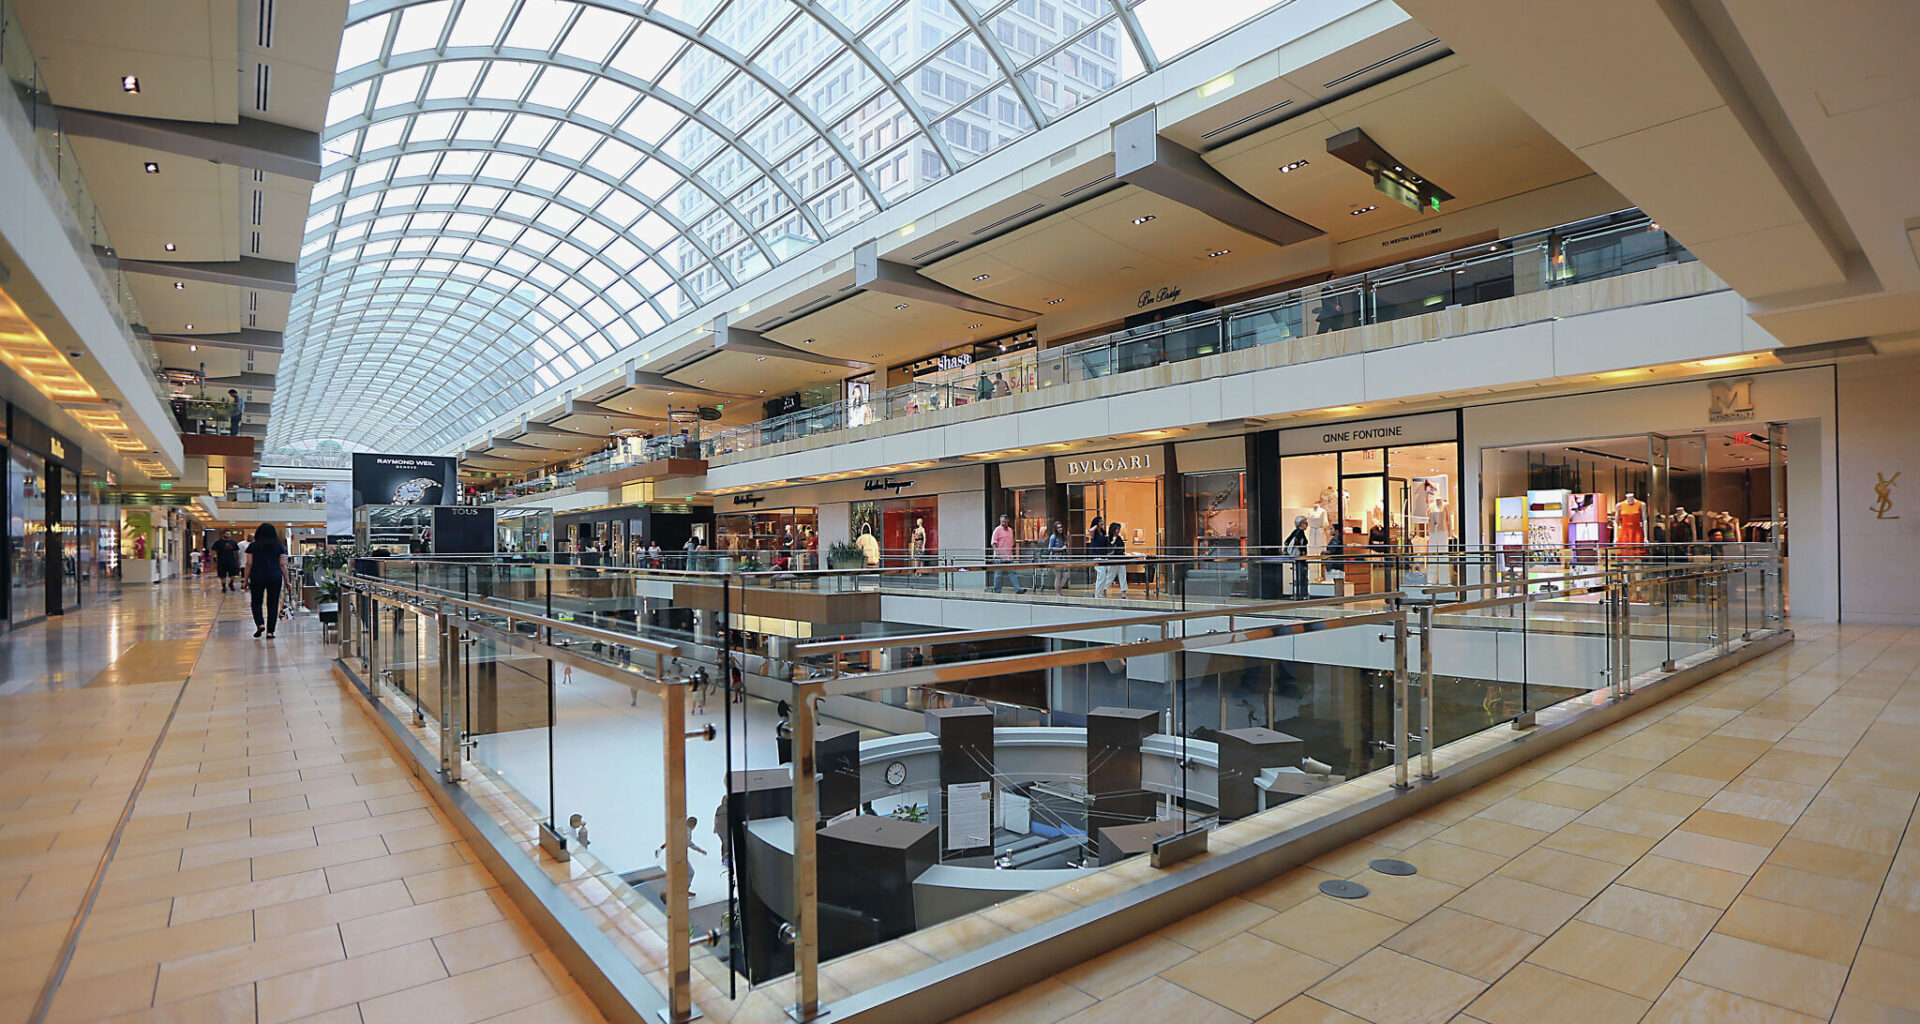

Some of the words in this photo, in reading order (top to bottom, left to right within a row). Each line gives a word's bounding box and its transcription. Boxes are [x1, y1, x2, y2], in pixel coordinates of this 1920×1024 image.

[1137, 290, 1155, 308] Ben
[1156, 285, 1182, 302] Bridge
[937, 353, 973, 371] shasa
[1010, 373, 1034, 389] SALE
[1707, 380, 1754, 414] M
[1068, 454, 1151, 475] BVLGARI
[452, 508, 478, 516] TOUS
